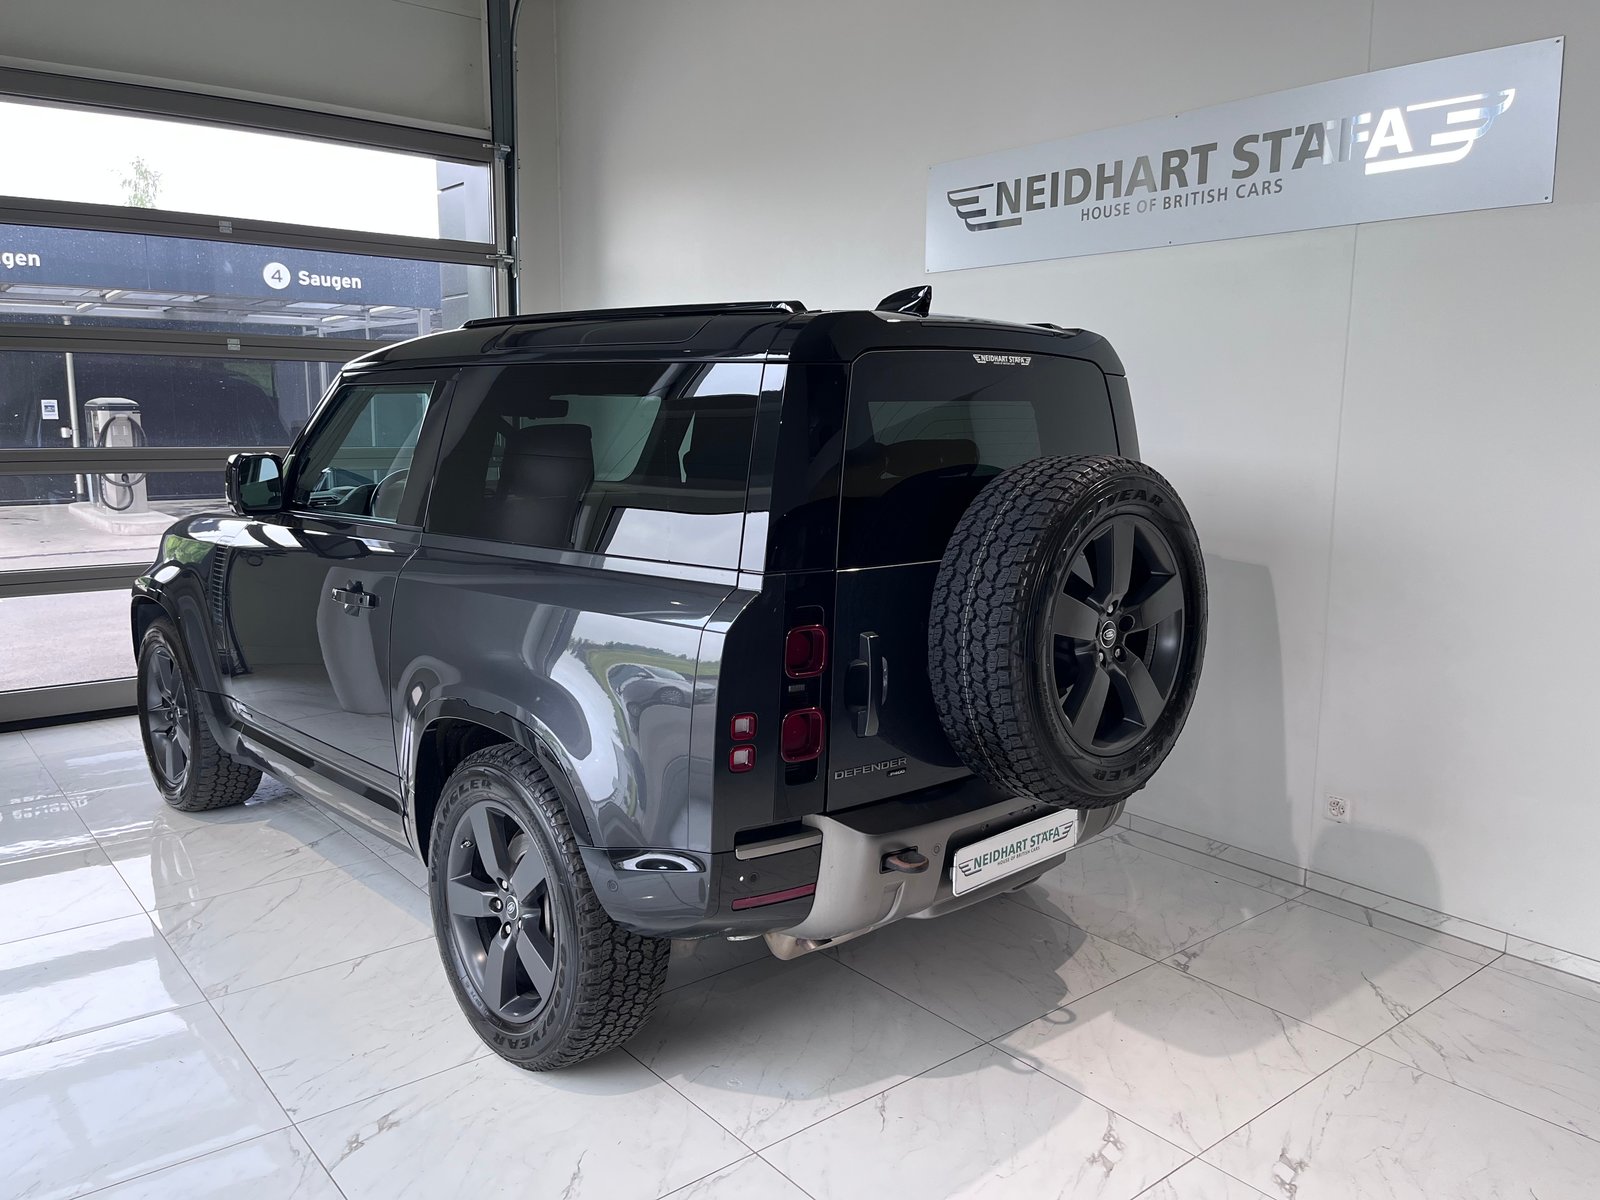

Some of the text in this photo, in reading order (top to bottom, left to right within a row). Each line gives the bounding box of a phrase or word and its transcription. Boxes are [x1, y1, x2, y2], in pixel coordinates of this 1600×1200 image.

[996, 107, 1413, 217] NEIDHART STÄFA
[1080, 177, 1284, 222] HOUSE OF BRITISH CARS
[0, 251, 41, 270] gen
[298, 270, 362, 291] Saugen
[834, 757, 907, 780] DEFENDER
[973, 826, 1060, 870] NEIDHART STÄFA
